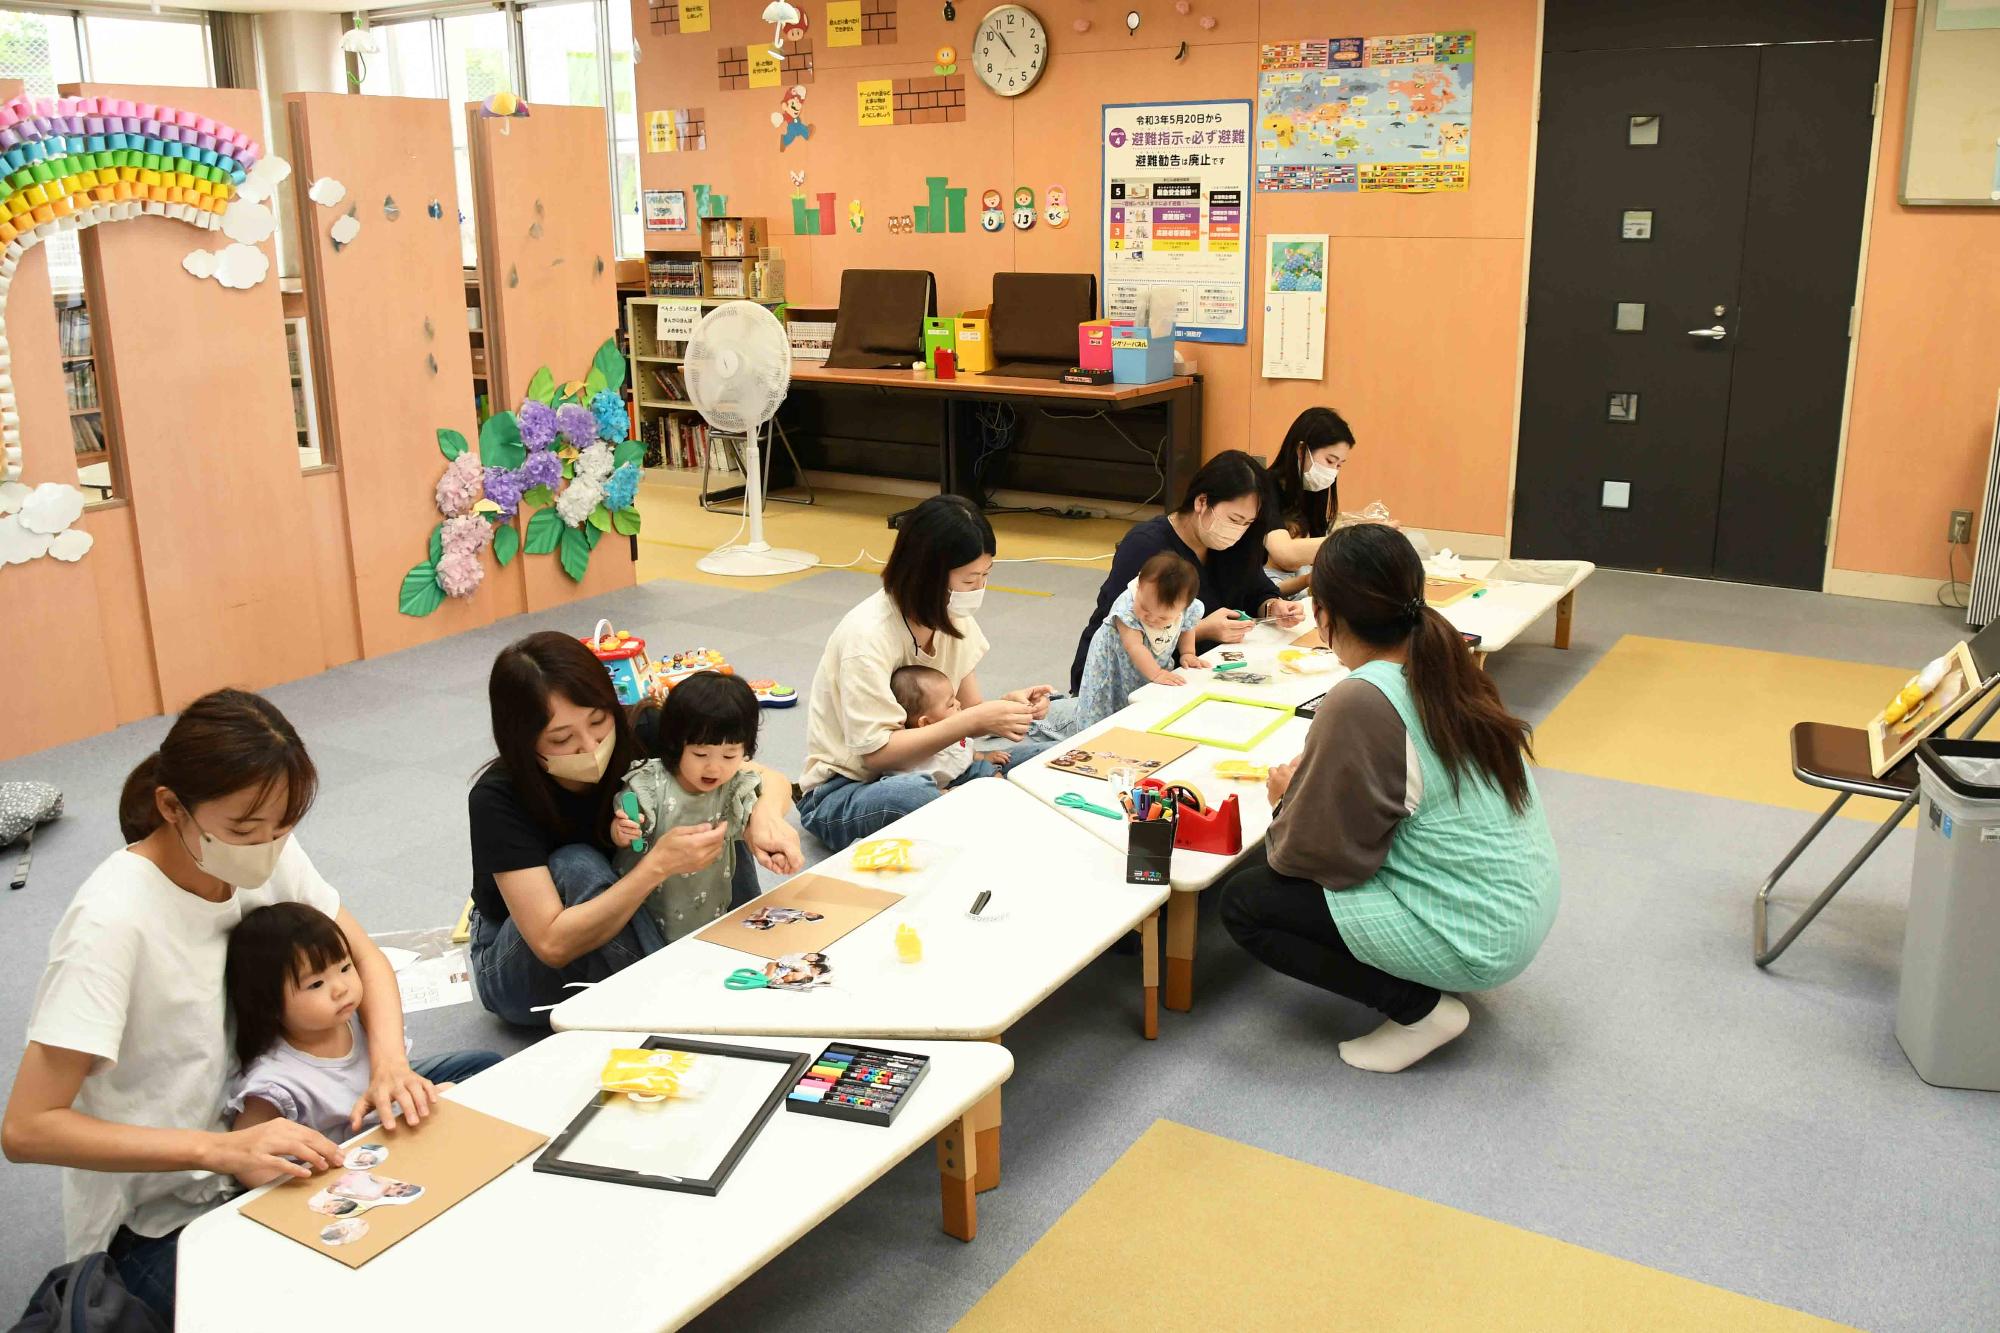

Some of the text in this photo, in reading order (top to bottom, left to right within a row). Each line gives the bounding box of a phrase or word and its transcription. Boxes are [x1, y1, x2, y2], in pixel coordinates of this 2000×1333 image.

[1006, 14, 1014, 24] 12
[996, 20, 1002, 29] 11
[986, 32, 994, 41] 10
[1030, 28, 1036, 38] 2
[983, 48, 988, 57] 9
[1034, 45, 1040, 54] 3
[987, 63, 992, 72] 8
[1031, 60, 1036, 69] 4
[997, 74, 1002, 83] 7
[1022, 72, 1027, 81] 5
[1009, 77, 1014, 86] 6
[1136, 113, 1222, 125] 令和3年5月20日から
[1131, 129, 1245, 146] 避難指示で必ず避難
[1136, 154, 1225, 167] 避難勧告は廃止です
[1018, 214, 1029, 224] 13
[1049, 212, 1061, 220] もく
[1115, 212, 1120, 220] 4
[988, 217, 993, 226] 6
